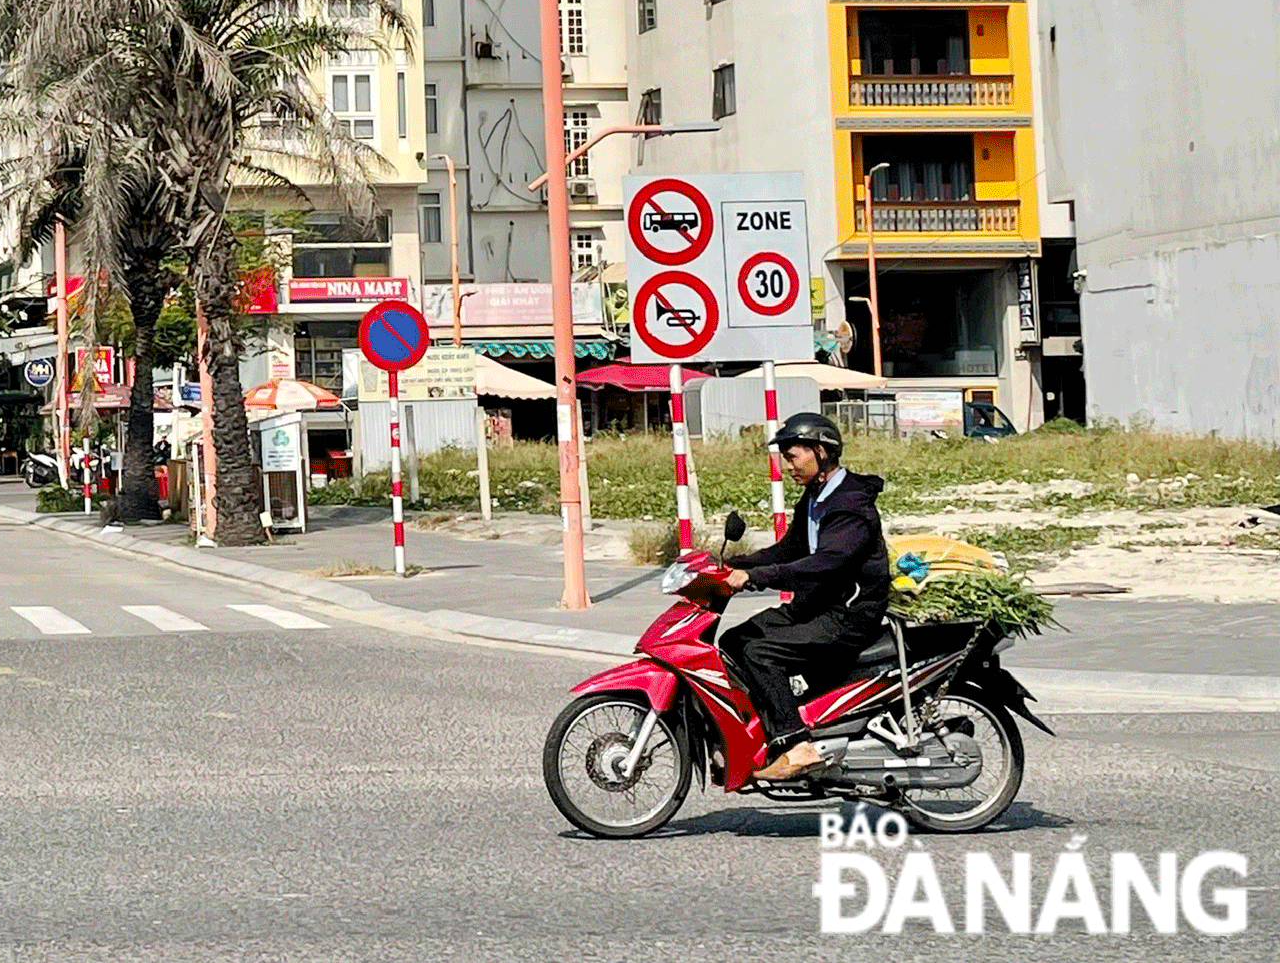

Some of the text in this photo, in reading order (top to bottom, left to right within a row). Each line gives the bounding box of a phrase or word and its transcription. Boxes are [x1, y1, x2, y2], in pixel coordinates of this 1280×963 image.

[736, 210, 792, 231] ZONE
[327, 281, 362, 296] NINA
[363, 281, 403, 296] MART
[754, 268, 784, 299] 30
